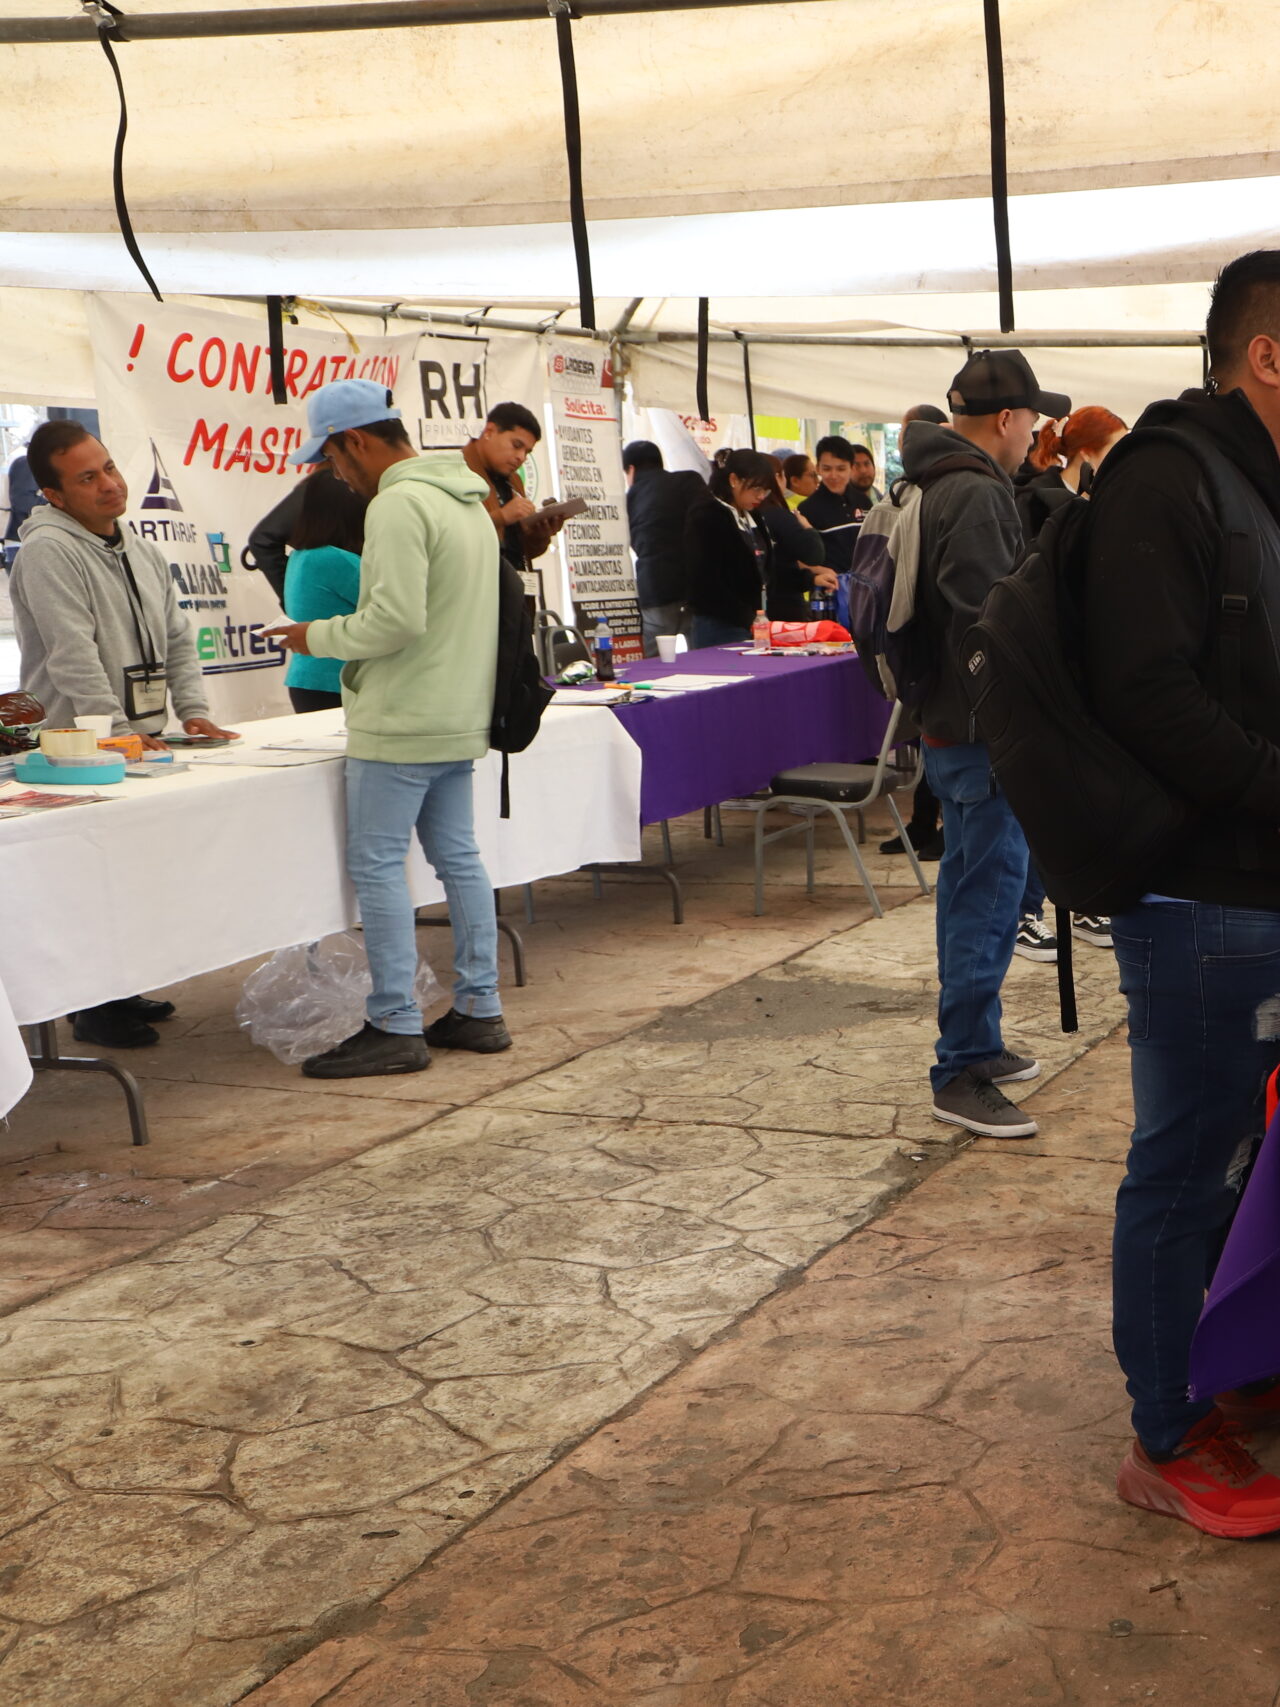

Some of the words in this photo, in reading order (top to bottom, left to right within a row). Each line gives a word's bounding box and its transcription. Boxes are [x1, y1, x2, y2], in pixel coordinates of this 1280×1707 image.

[418, 360, 484, 419] RH
[564, 397, 607, 416] Solicita:
[573, 559, 623, 577] ALMACENISTAS
